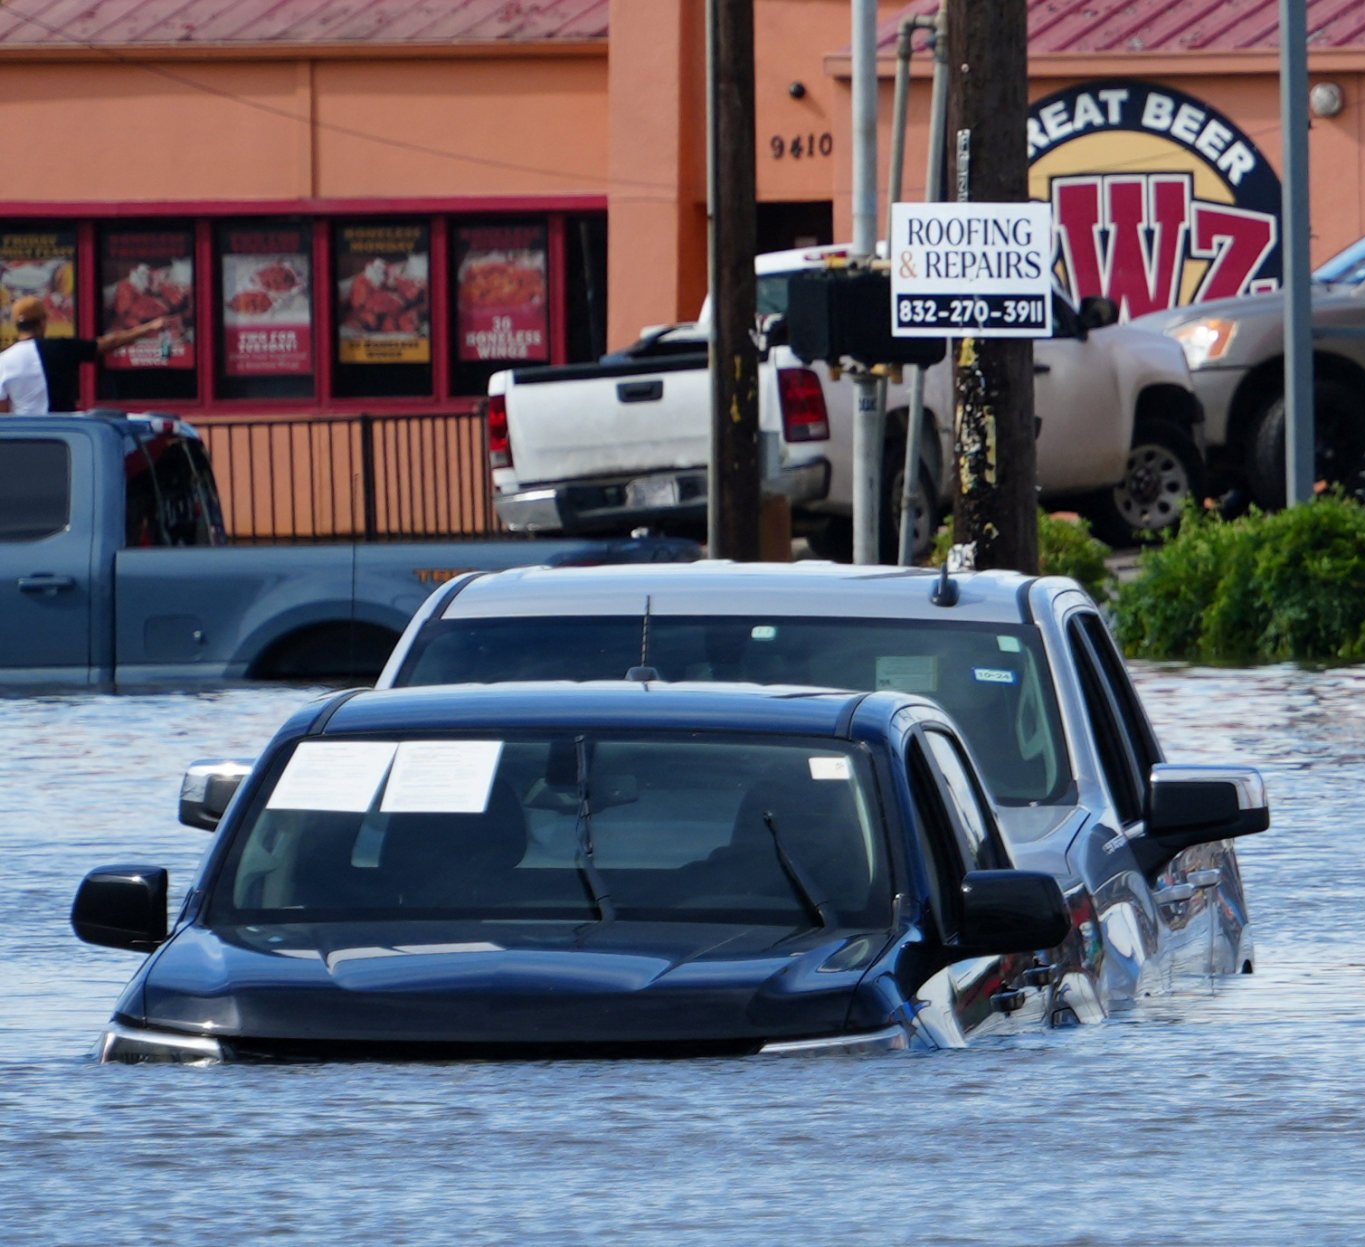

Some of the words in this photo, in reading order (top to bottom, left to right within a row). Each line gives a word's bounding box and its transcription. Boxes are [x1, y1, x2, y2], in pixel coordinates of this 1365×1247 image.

[770, 133, 833, 160] 9410
[1027, 89, 1129, 156] REAT
[1141, 92, 1256, 186] BEER
[908, 218, 1032, 246] ROOFING
[900, 251, 917, 278] &
[926, 251, 1041, 279] REPAIRS
[899, 299, 1043, 323] 832-270-3911
